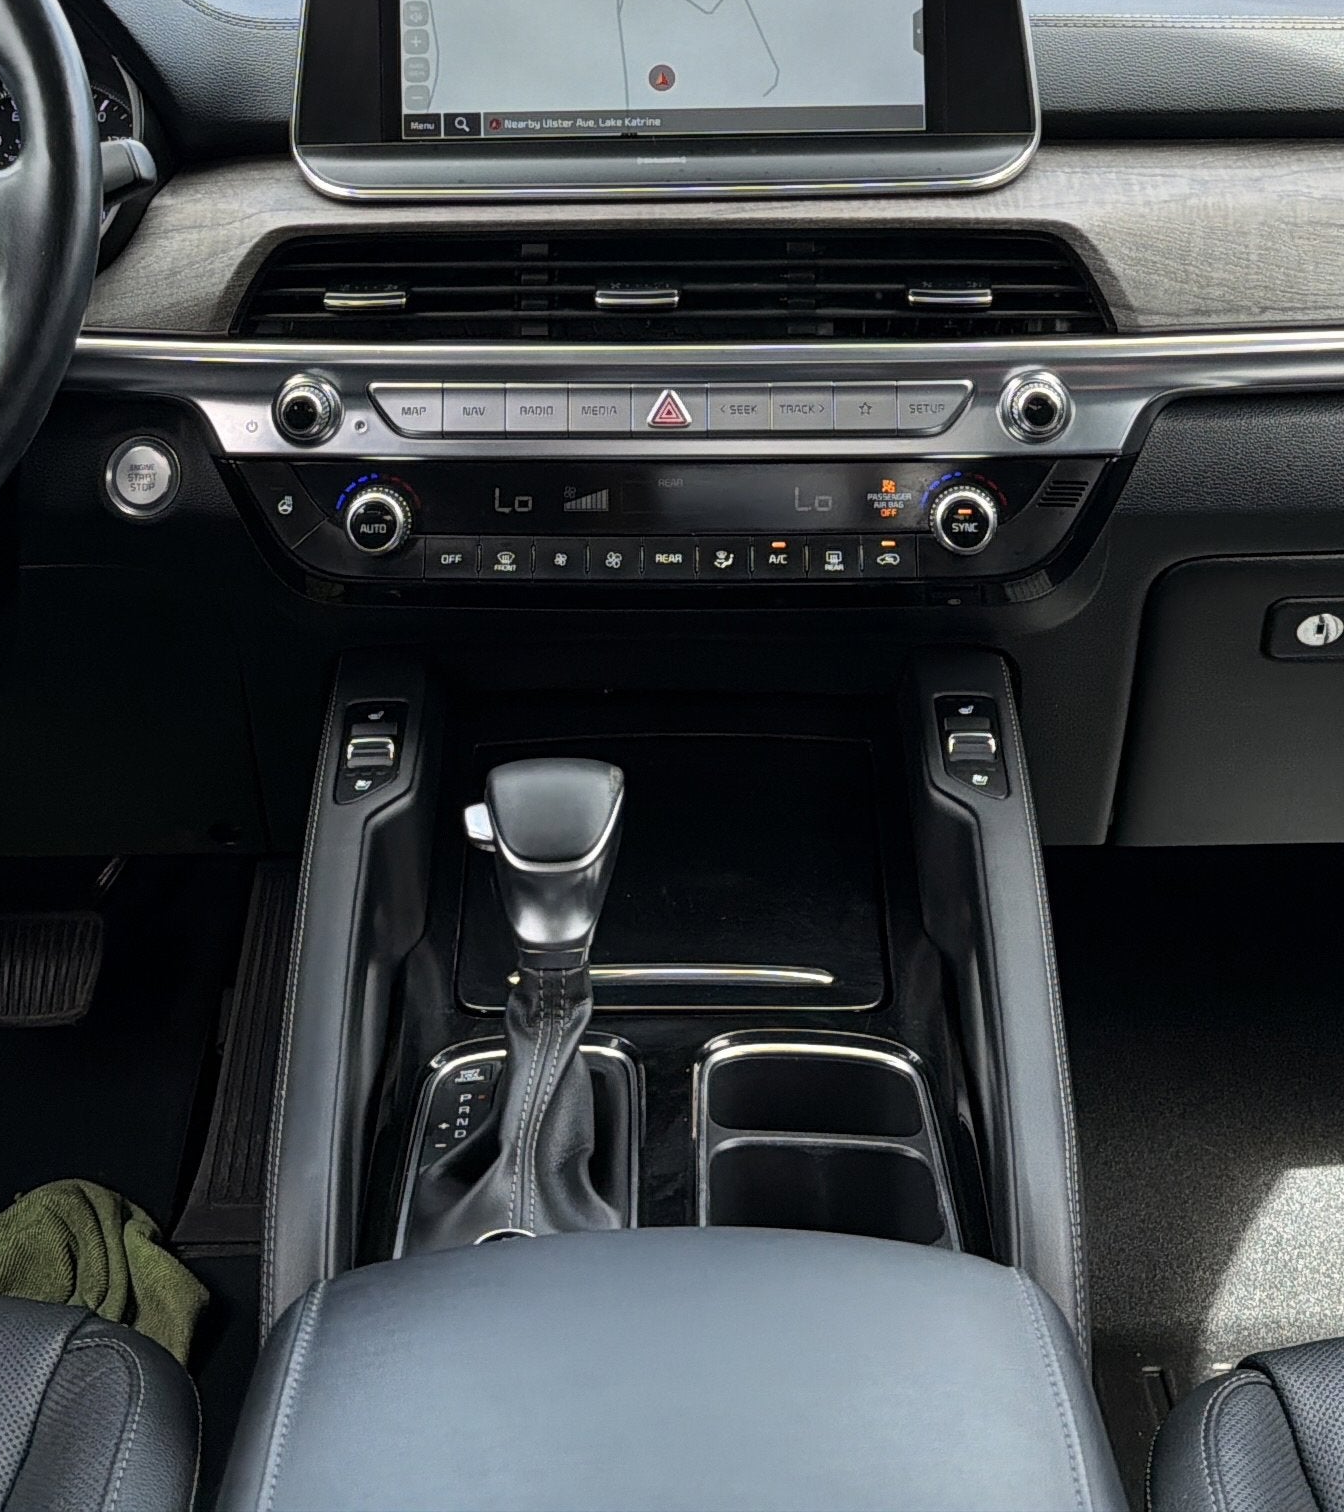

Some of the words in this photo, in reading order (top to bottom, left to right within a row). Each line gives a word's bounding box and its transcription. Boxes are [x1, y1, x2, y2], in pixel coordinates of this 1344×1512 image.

[410, 121, 435, 131] Menu
[504, 119, 541, 131] Nearby
[542, 118, 572, 128] Ulster
[598, 117, 623, 127] Lake
[624, 117, 662, 126] Katrine
[401, 406, 427, 416] MAP
[462, 406, 486, 416] NAV
[519, 405, 554, 416] RADIO
[581, 405, 617, 415] MEDIA
[730, 404, 758, 414] SEEK
[779, 404, 815, 414] TRACK
[909, 403, 945, 414] SETUP
[127, 473, 157, 482] START
[130, 483, 155, 492] STOP
[867, 492, 912, 501] PASSENGER
[873, 500, 887, 509] AIR
[888, 500, 905, 509] BAG
[880, 508, 898, 517] OFF
[360, 523, 386, 534] AUTO
[951, 522, 979, 533] SYNC
[440, 555, 462, 565] OFF
[656, 553, 682, 563] REAR
[769, 553, 788, 565] A/C
[459, 1093, 472, 1103] P
[458, 1105, 470, 1115] R
[456, 1117, 469, 1127] N
[454, 1129, 467, 1138] D
